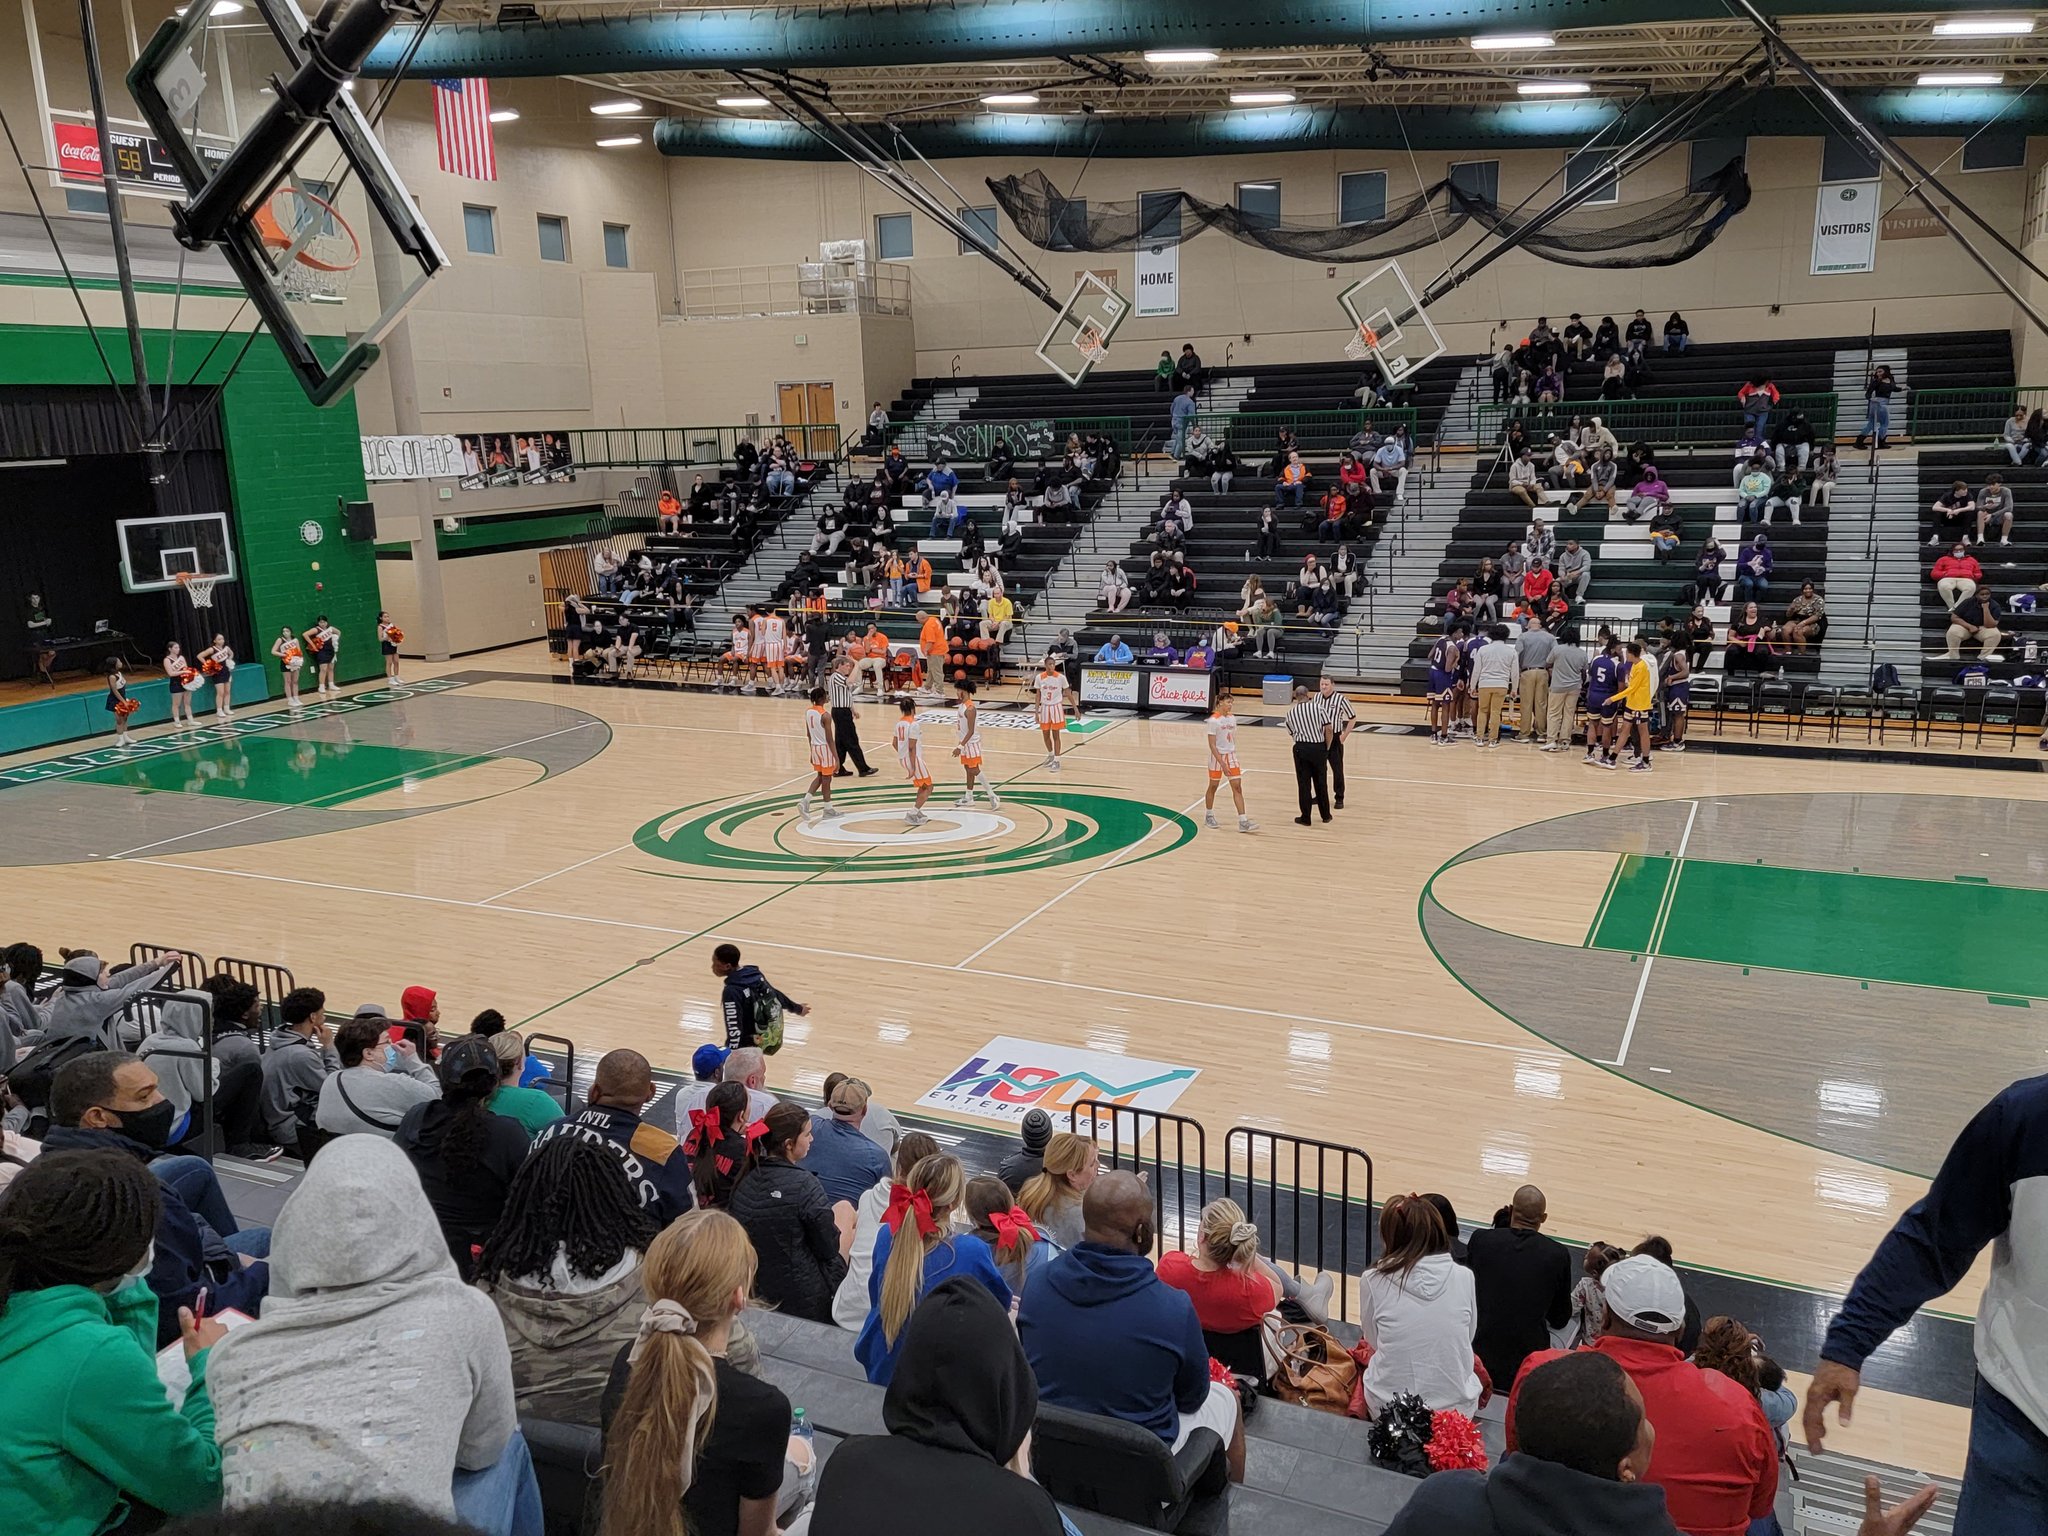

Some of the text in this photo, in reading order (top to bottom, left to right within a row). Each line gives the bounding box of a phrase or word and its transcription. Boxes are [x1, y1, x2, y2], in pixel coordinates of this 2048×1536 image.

[109, 134, 141, 148] GUEST
[117, 148, 143, 172] 58
[204, 149, 232, 161] HOME
[153, 172, 181, 184] PERIOD
[1820, 222, 1871, 236] VISITORS
[1140, 271, 1174, 286] HOME
[1391, 360, 1401, 371] 2
[954, 423, 1029, 458] SENIORS
[402, 439, 424, 476] on
[1596, 667, 1607, 683] 5
[1086, 693, 1130, 702] 423-763-0385
[1151, 679, 1207, 703] Chick-fil-A
[927, 1090, 1111, 1131] ENTERPISES
[575, 1110, 612, 1130] INTL
